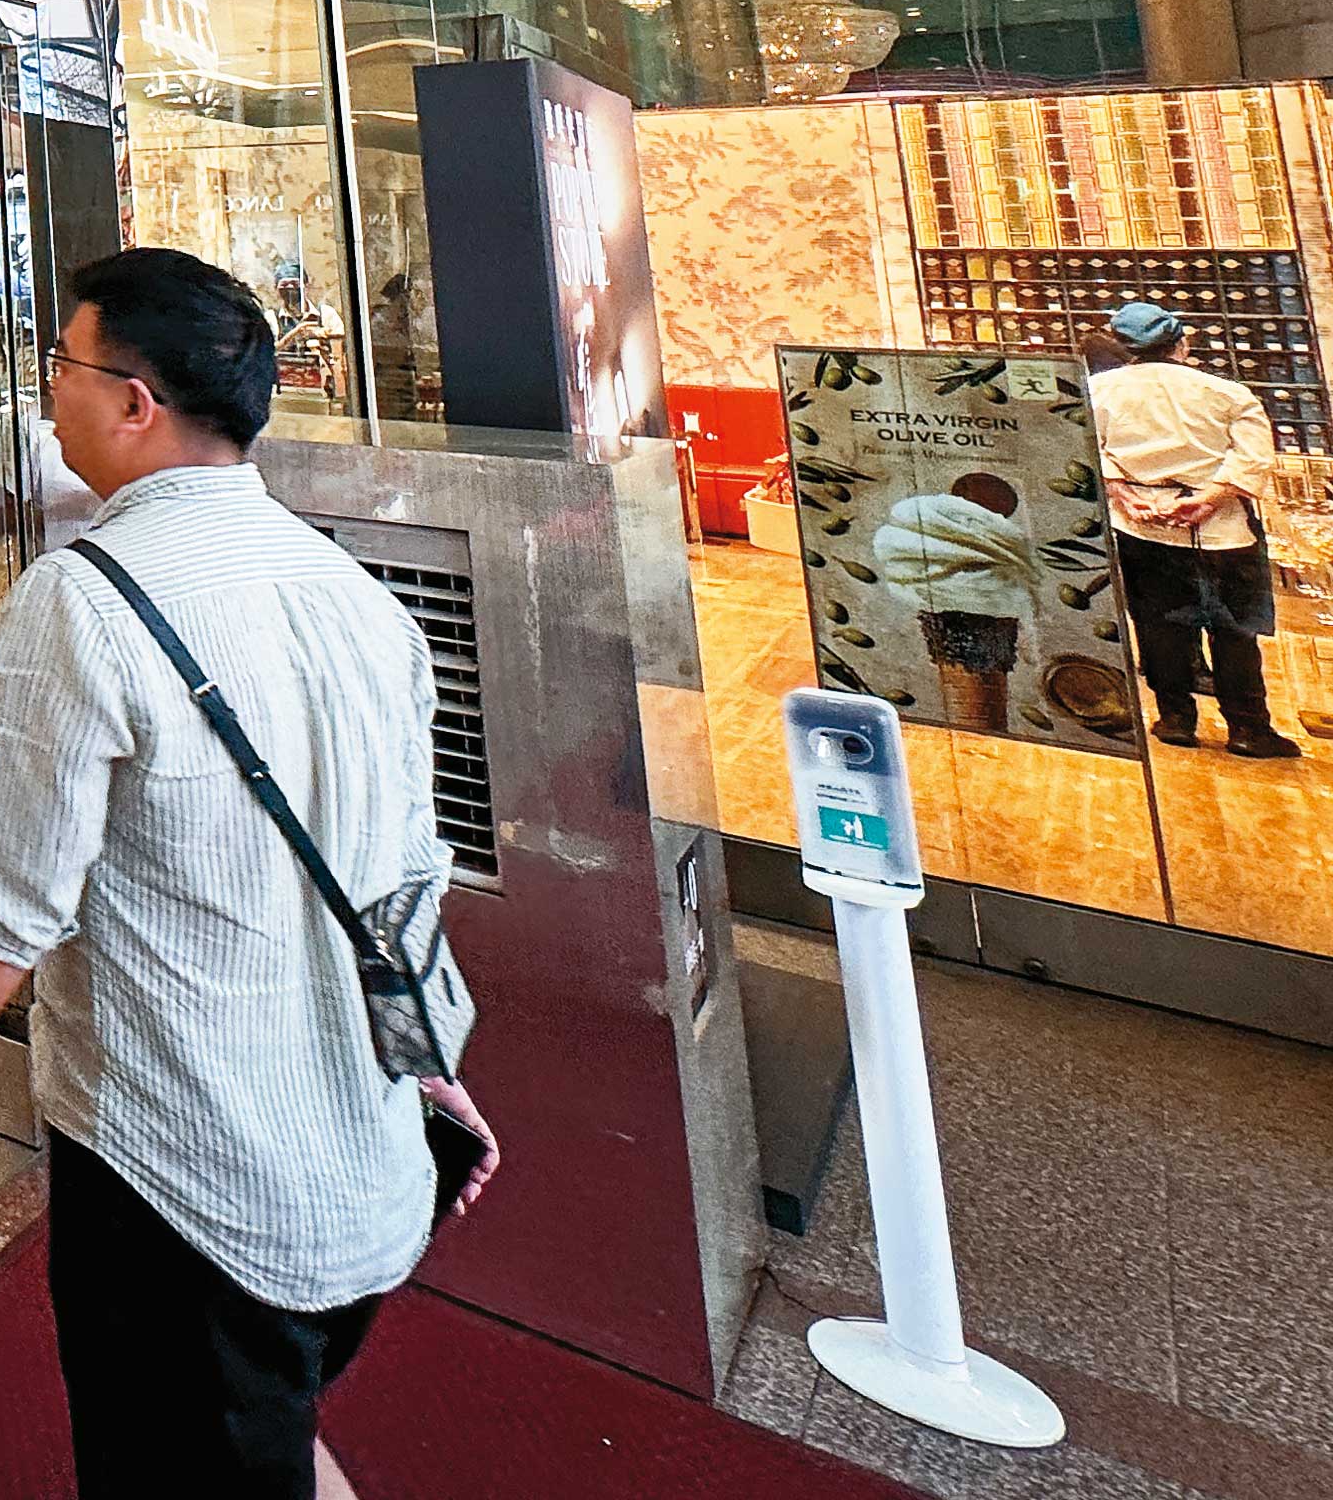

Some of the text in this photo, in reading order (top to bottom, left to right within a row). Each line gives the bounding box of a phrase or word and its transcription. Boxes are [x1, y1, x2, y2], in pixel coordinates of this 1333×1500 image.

[850, 409, 1019, 431] EXTRA VIRGIN
[877, 428, 995, 447] OLIVE OIL
